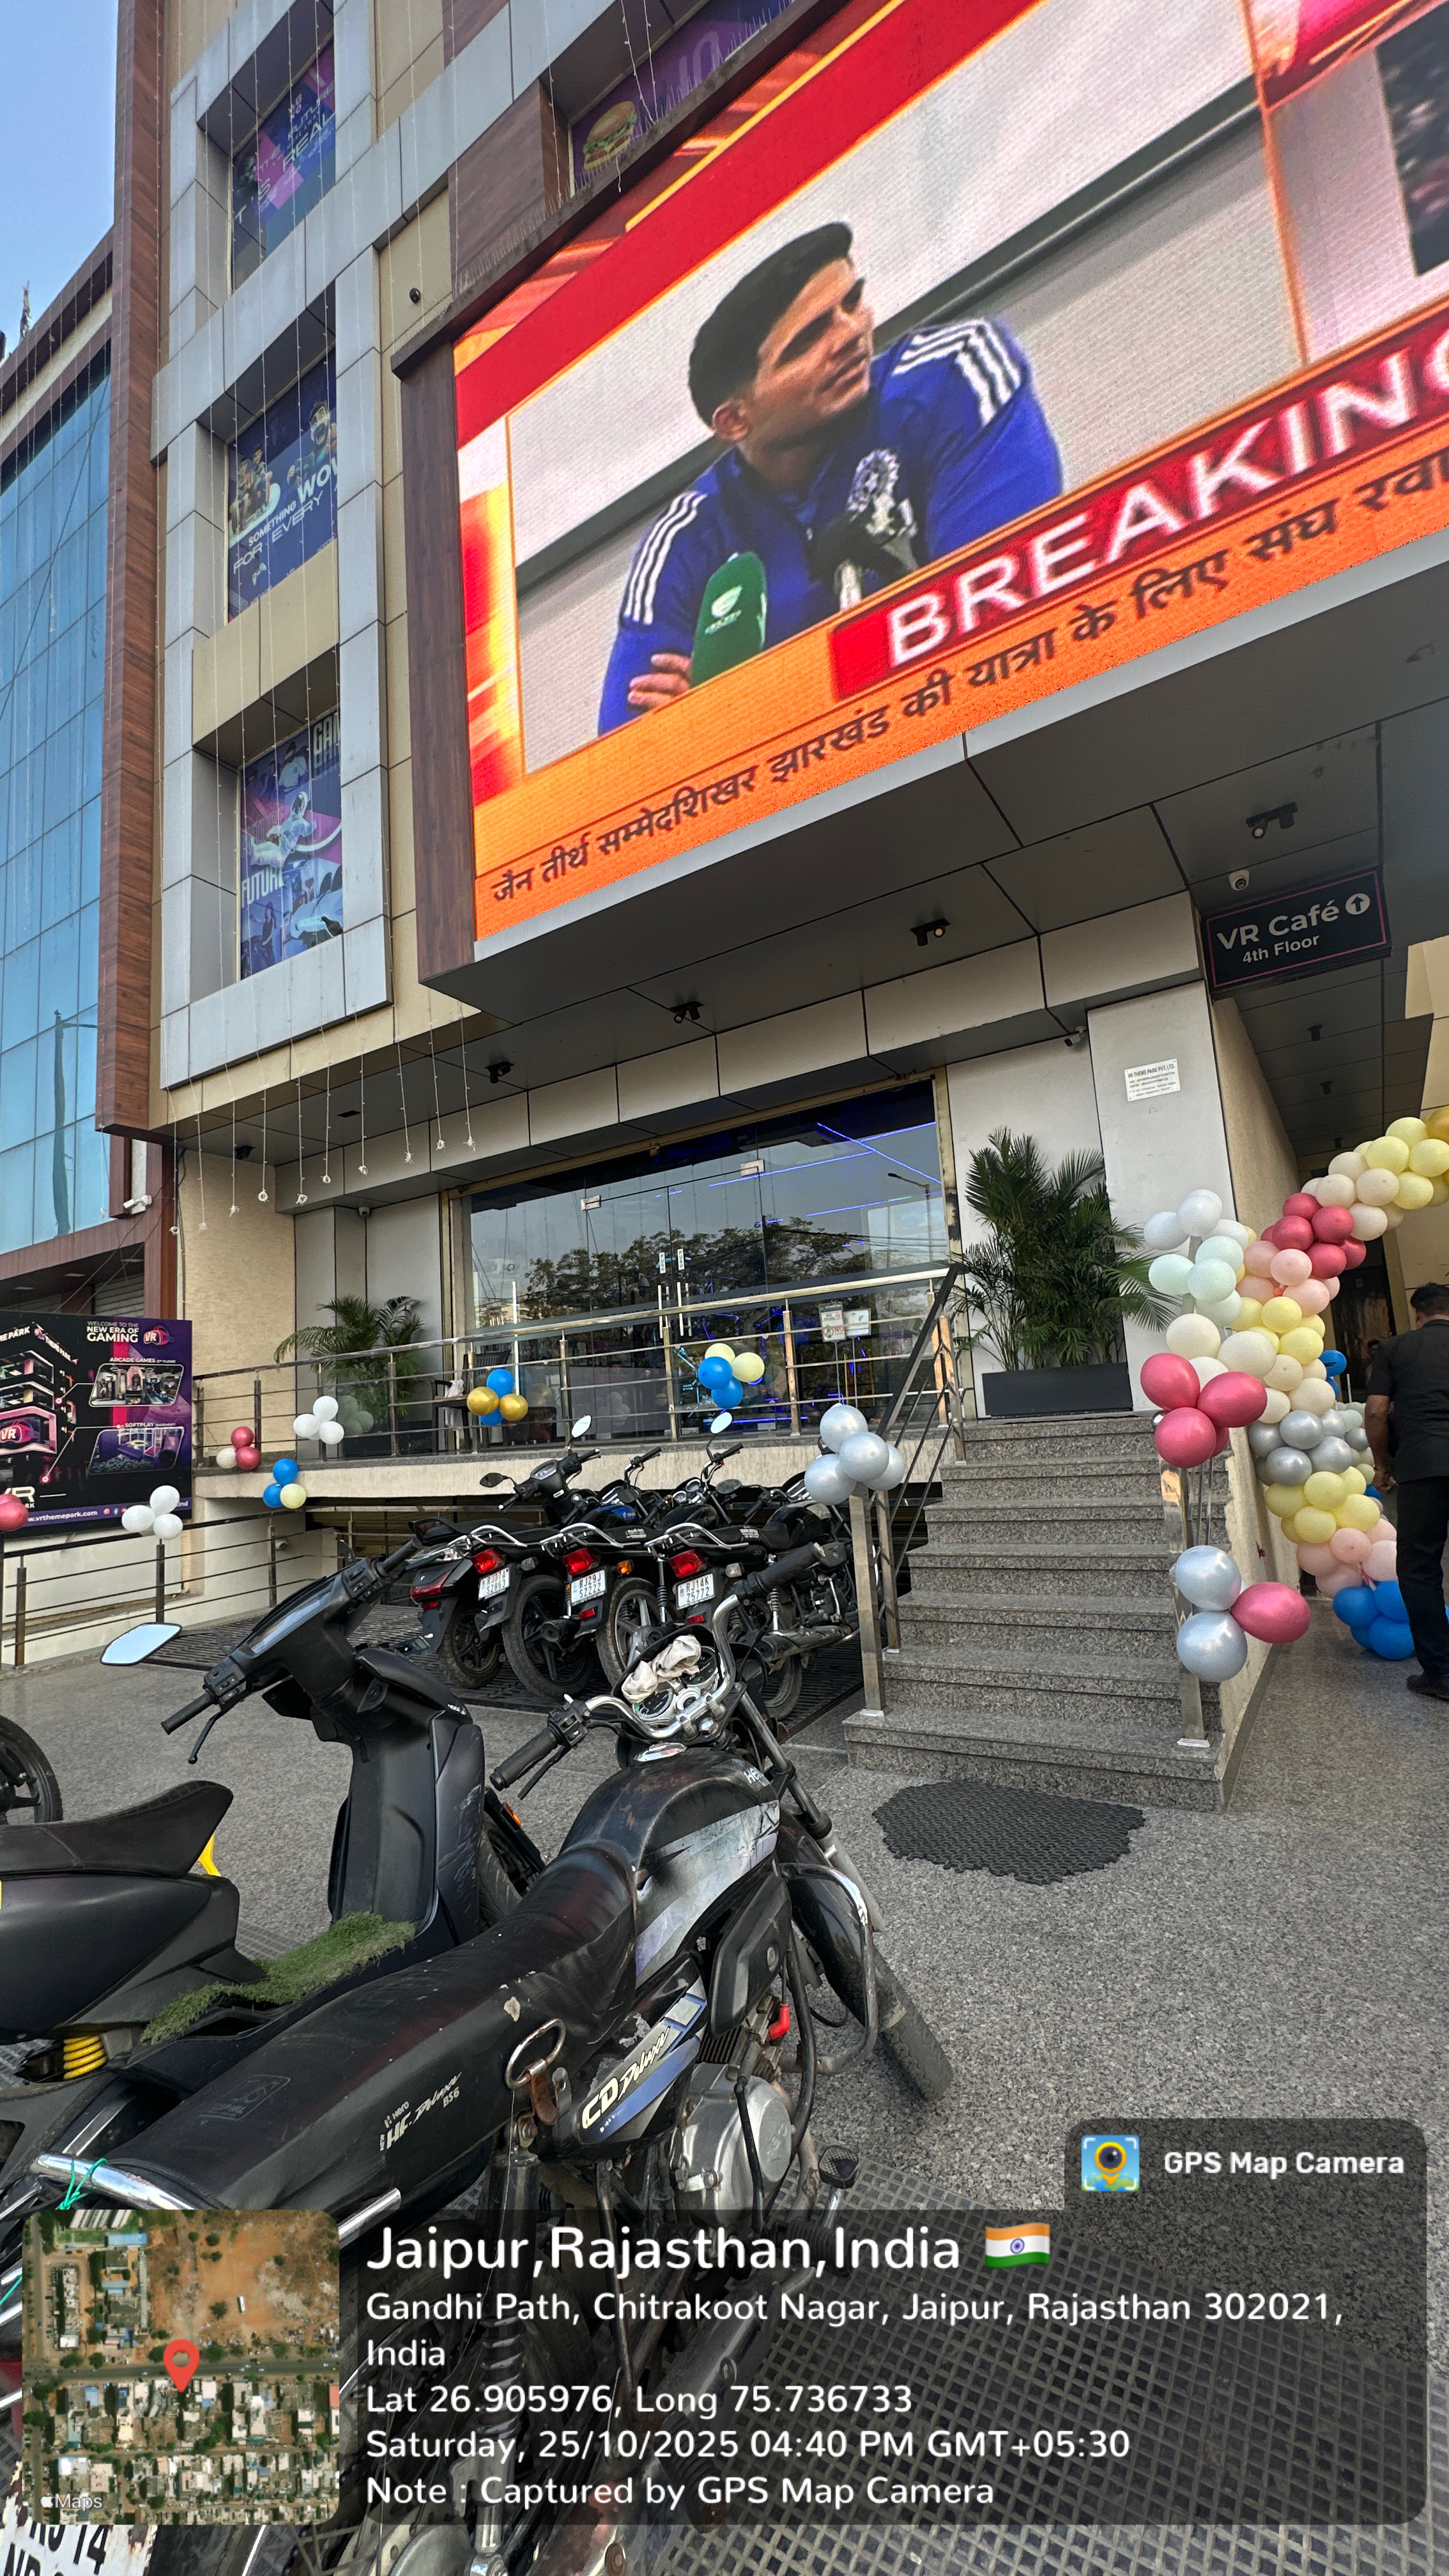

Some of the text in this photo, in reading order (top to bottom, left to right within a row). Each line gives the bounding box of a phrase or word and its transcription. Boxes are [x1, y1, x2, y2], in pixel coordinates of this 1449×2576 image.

[283, 112, 335, 172] REAL
[233, 489, 323, 574] FOR EVERY
[249, 500, 296, 546] SOMETHING
[491, 866, 535, 901] जैन
[540, 831, 592, 883] तीर्थ
[596, 764, 758, 855] सम्मेदशिखर
[766, 704, 891, 783] झारखंड
[900, 668, 955, 718] की
[966, 627, 1059, 687] यात्रा
[1069, 602, 1119, 643] के
[1130, 548, 1232, 620] लिए
[1242, 496, 1342, 562] संघ
[1216, 900, 1340, 950] VR Café
[1243, 935, 1321, 963] 4th Floor
[8, 1326, 31, 1340] PARK
[86, 1332, 139, 1343] GAMING
[145, 1332, 157, 1342] VR
[0, 1427, 17, 1440] VR
[579, 1572, 601, 1589] RJ29J
[579, 1582, 601, 1598] S2222
[686, 1575, 709, 1593] RJ14K
[686, 1586, 710, 1603] Z5772
[443, 2085, 460, 2108] BS6
[581, 2077, 619, 2129] CD
